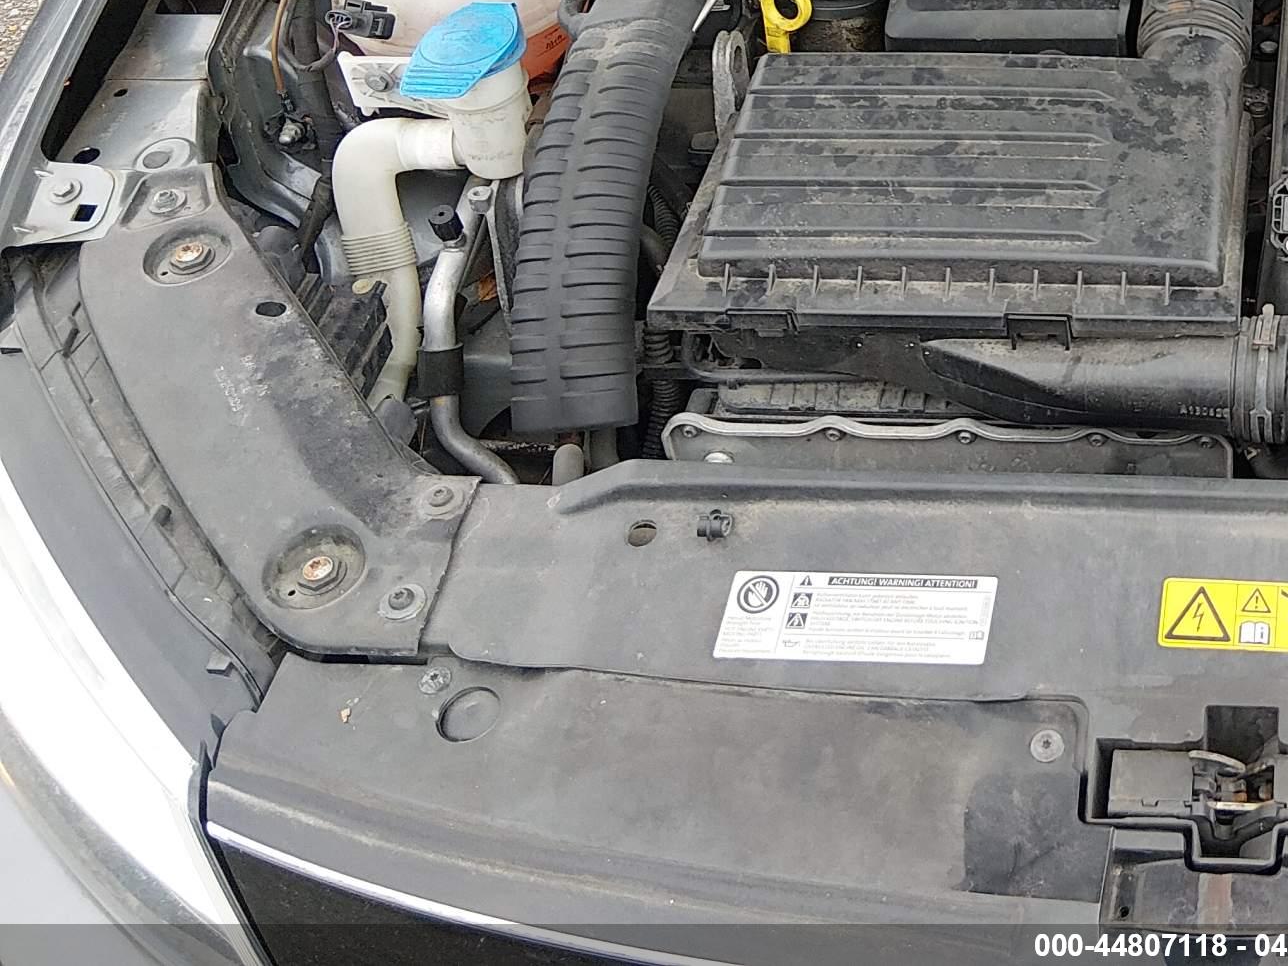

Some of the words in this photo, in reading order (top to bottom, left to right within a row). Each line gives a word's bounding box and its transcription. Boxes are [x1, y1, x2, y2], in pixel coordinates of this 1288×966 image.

[831, 577, 878, 586] ACHTUNG!
[879, 578, 924, 588] WARNING!
[925, 579, 976, 588] ATTENTION!
